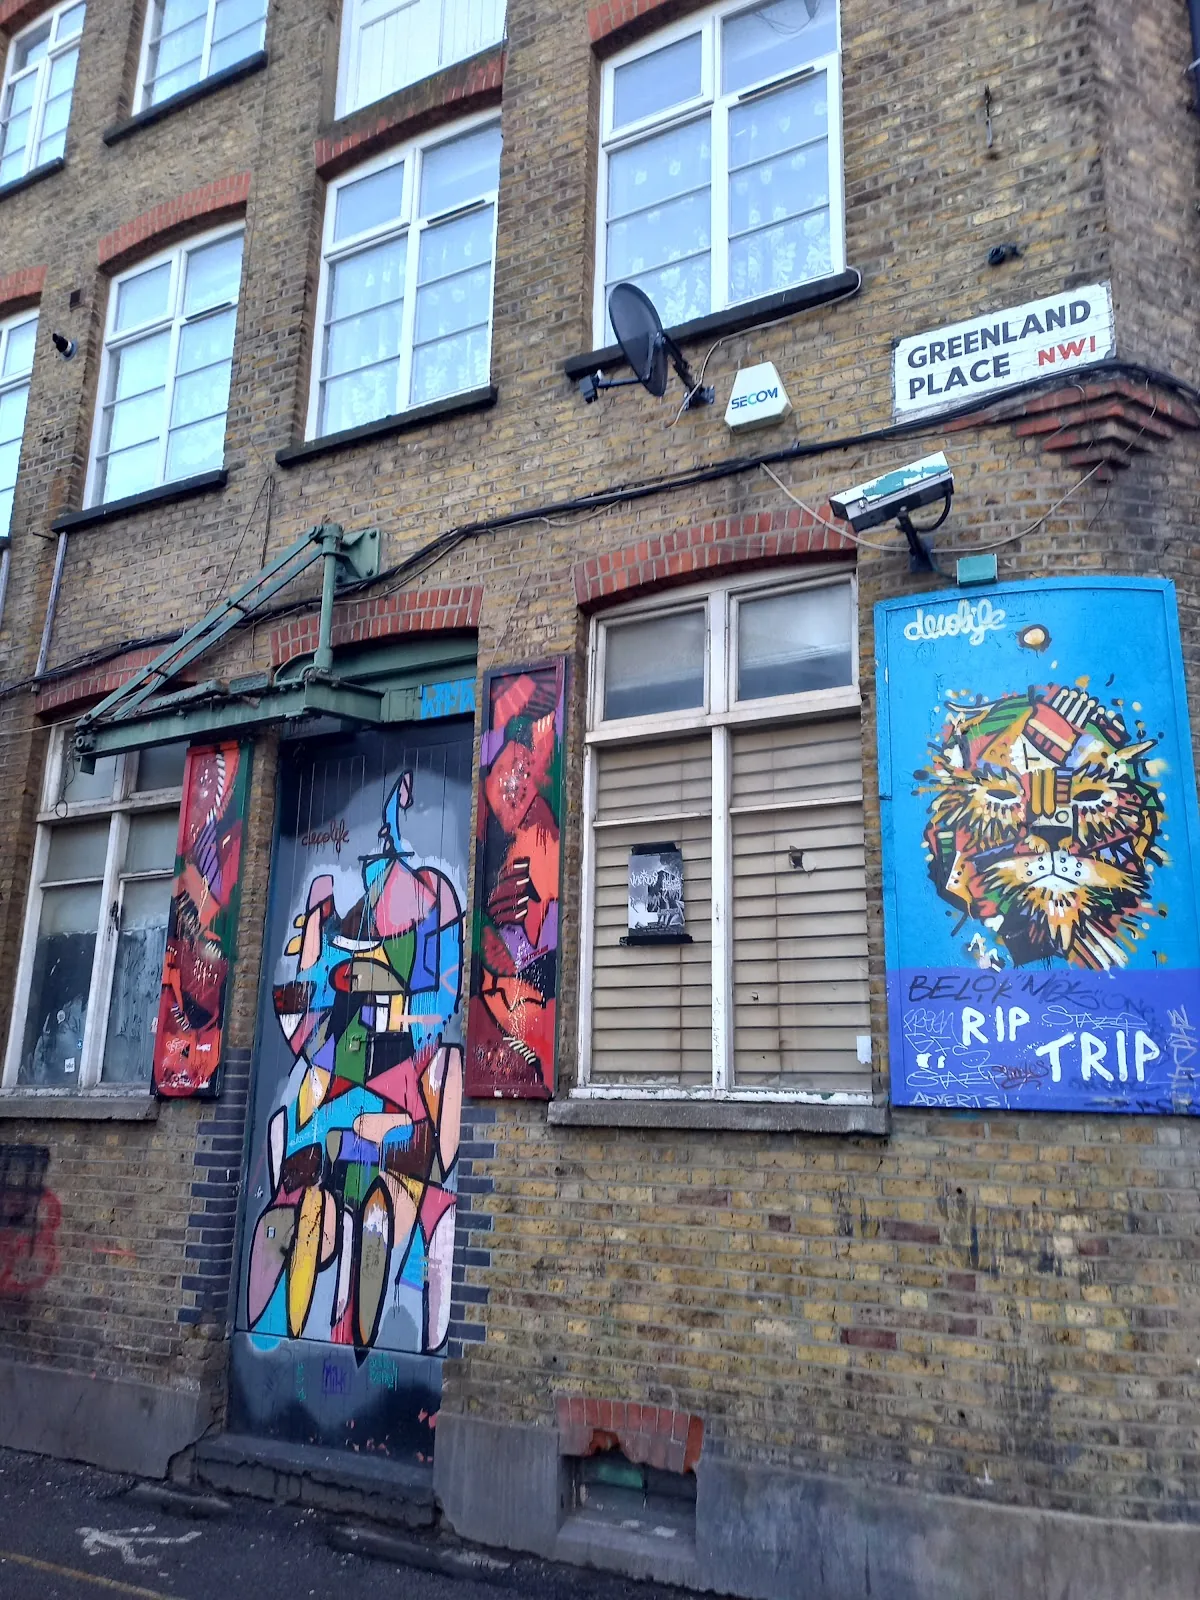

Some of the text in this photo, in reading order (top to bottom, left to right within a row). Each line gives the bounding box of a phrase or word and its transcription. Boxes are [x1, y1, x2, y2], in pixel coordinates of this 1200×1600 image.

[907, 300, 1092, 369] GREENLAND
[731, 387, 778, 410] SECOM
[909, 352, 1011, 400] PLACE
[961, 1005, 1030, 1046] RIP
[1035, 1030, 1160, 1083] TRIP
